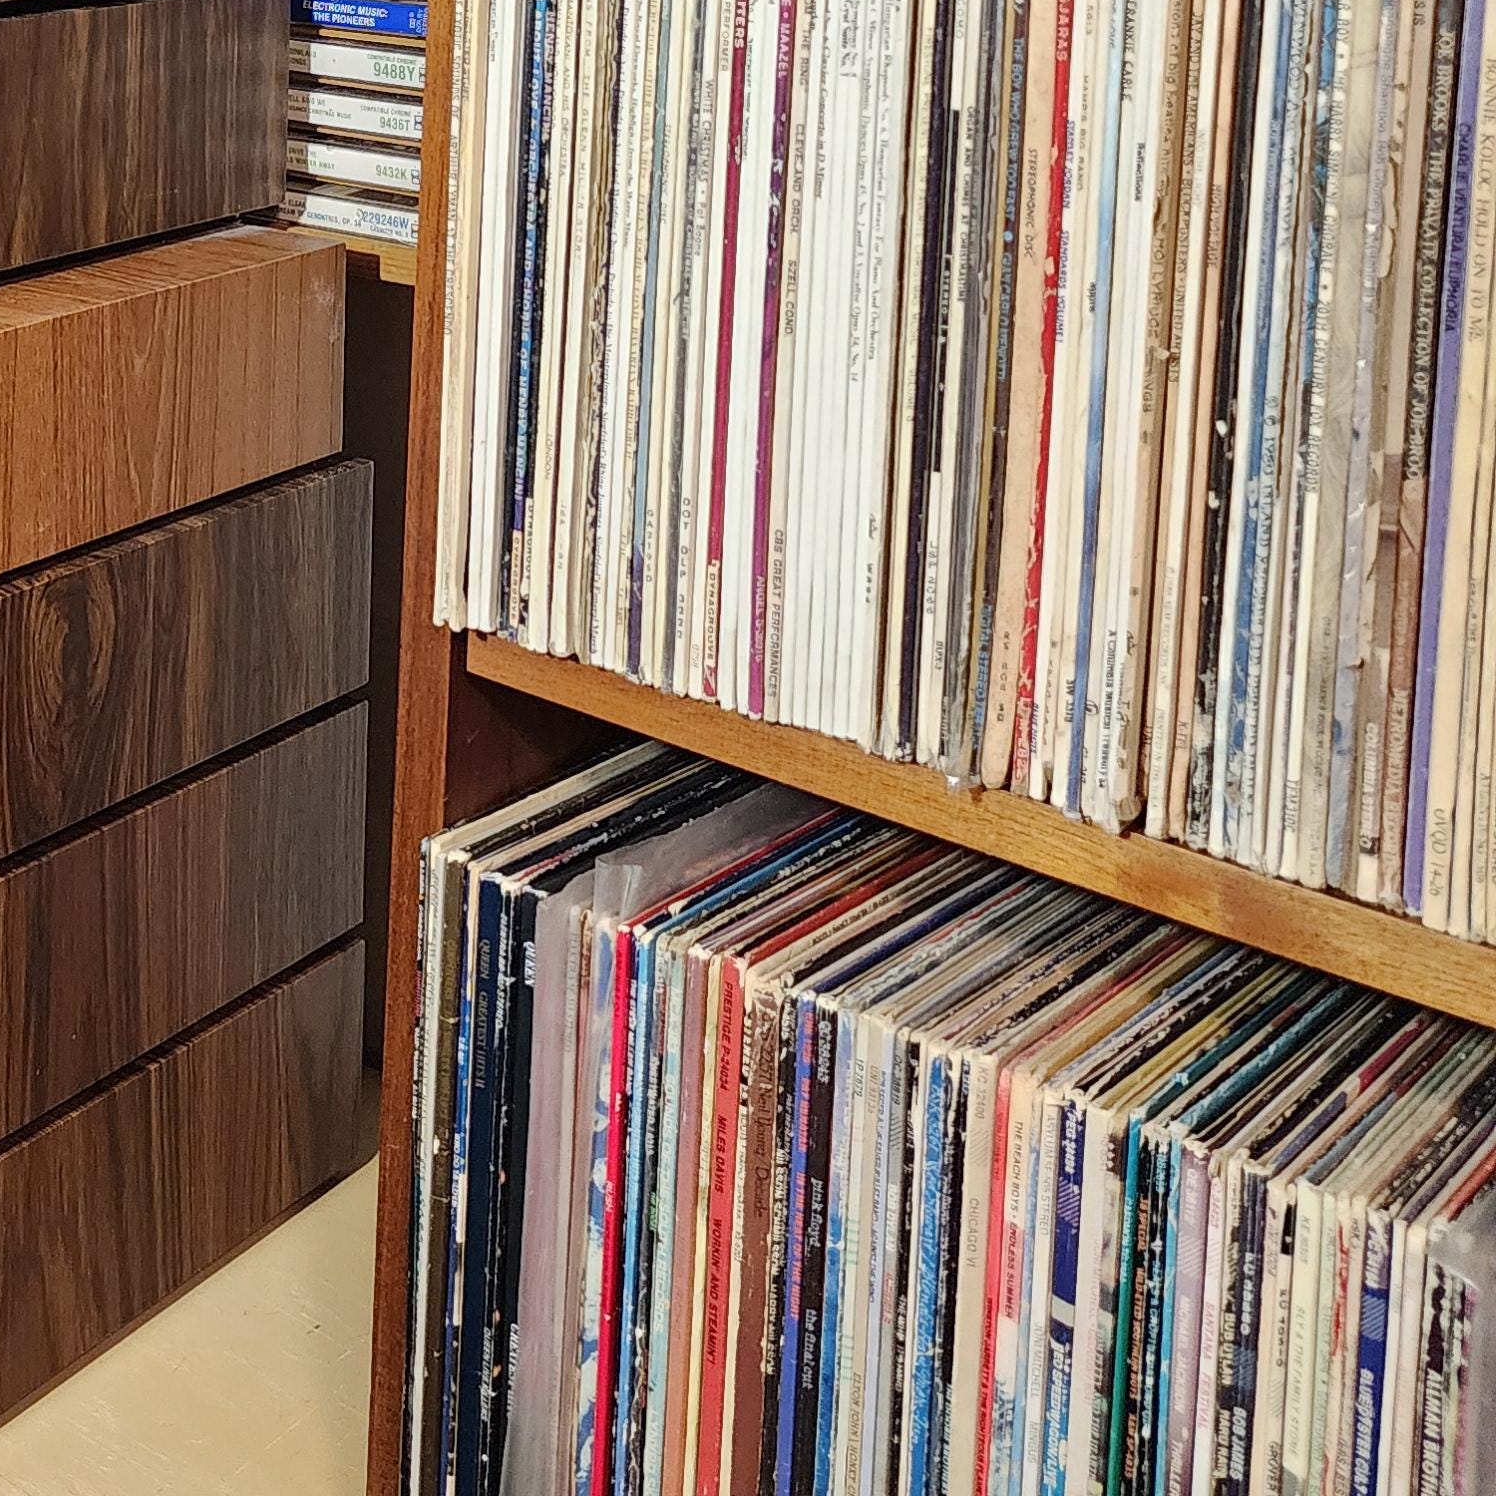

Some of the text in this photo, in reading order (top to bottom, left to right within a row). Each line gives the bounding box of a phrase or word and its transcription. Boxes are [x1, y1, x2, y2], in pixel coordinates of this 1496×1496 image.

[302, 0, 356, 14] ELECTRONIC
[312, 12, 375, 26] THE PIONEERS
[720, 0, 732, 72] PERFORMER
[778, 23, 791, 78] MAAZEL
[1122, 0, 1136, 103] FRANKIE CARLE
[373, 62, 416, 82] 9488Y
[379, 116, 410, 131] 9436T
[376, 164, 407, 180] 9432K
[1024, 148, 1038, 258] STEREOPHONIC DISC
[1414, 29, 1453, 387] JOE BROOKS THE PRIVATE COLLECTION OF
[544, 433, 554, 481] LONDON
[510, 536, 522, 622] DYNAGROOVE
[706, 572, 718, 662] DYNAGROOVE
[766, 529, 784, 698] CBS GREAT PERFORMANCES
[523, 940, 535, 987] QUEEN
[720, 980, 734, 1047] PRESTIGE
[716, 1115, 728, 1155] MILES
[714, 1157, 726, 1194] DAVIS
[711, 1218, 724, 1268] WORKIN'
[1005, 1120, 1024, 1320] THE BEACH BOYS ENDLESS SUMMER
[709, 1271, 720, 1299] AND
[1196, 1301, 1215, 1428] SANTANA FESTIVAL
[1423, 1369, 1442, 1426] ALLMAN
[1265, 1441, 1279, 1495] GROVER
